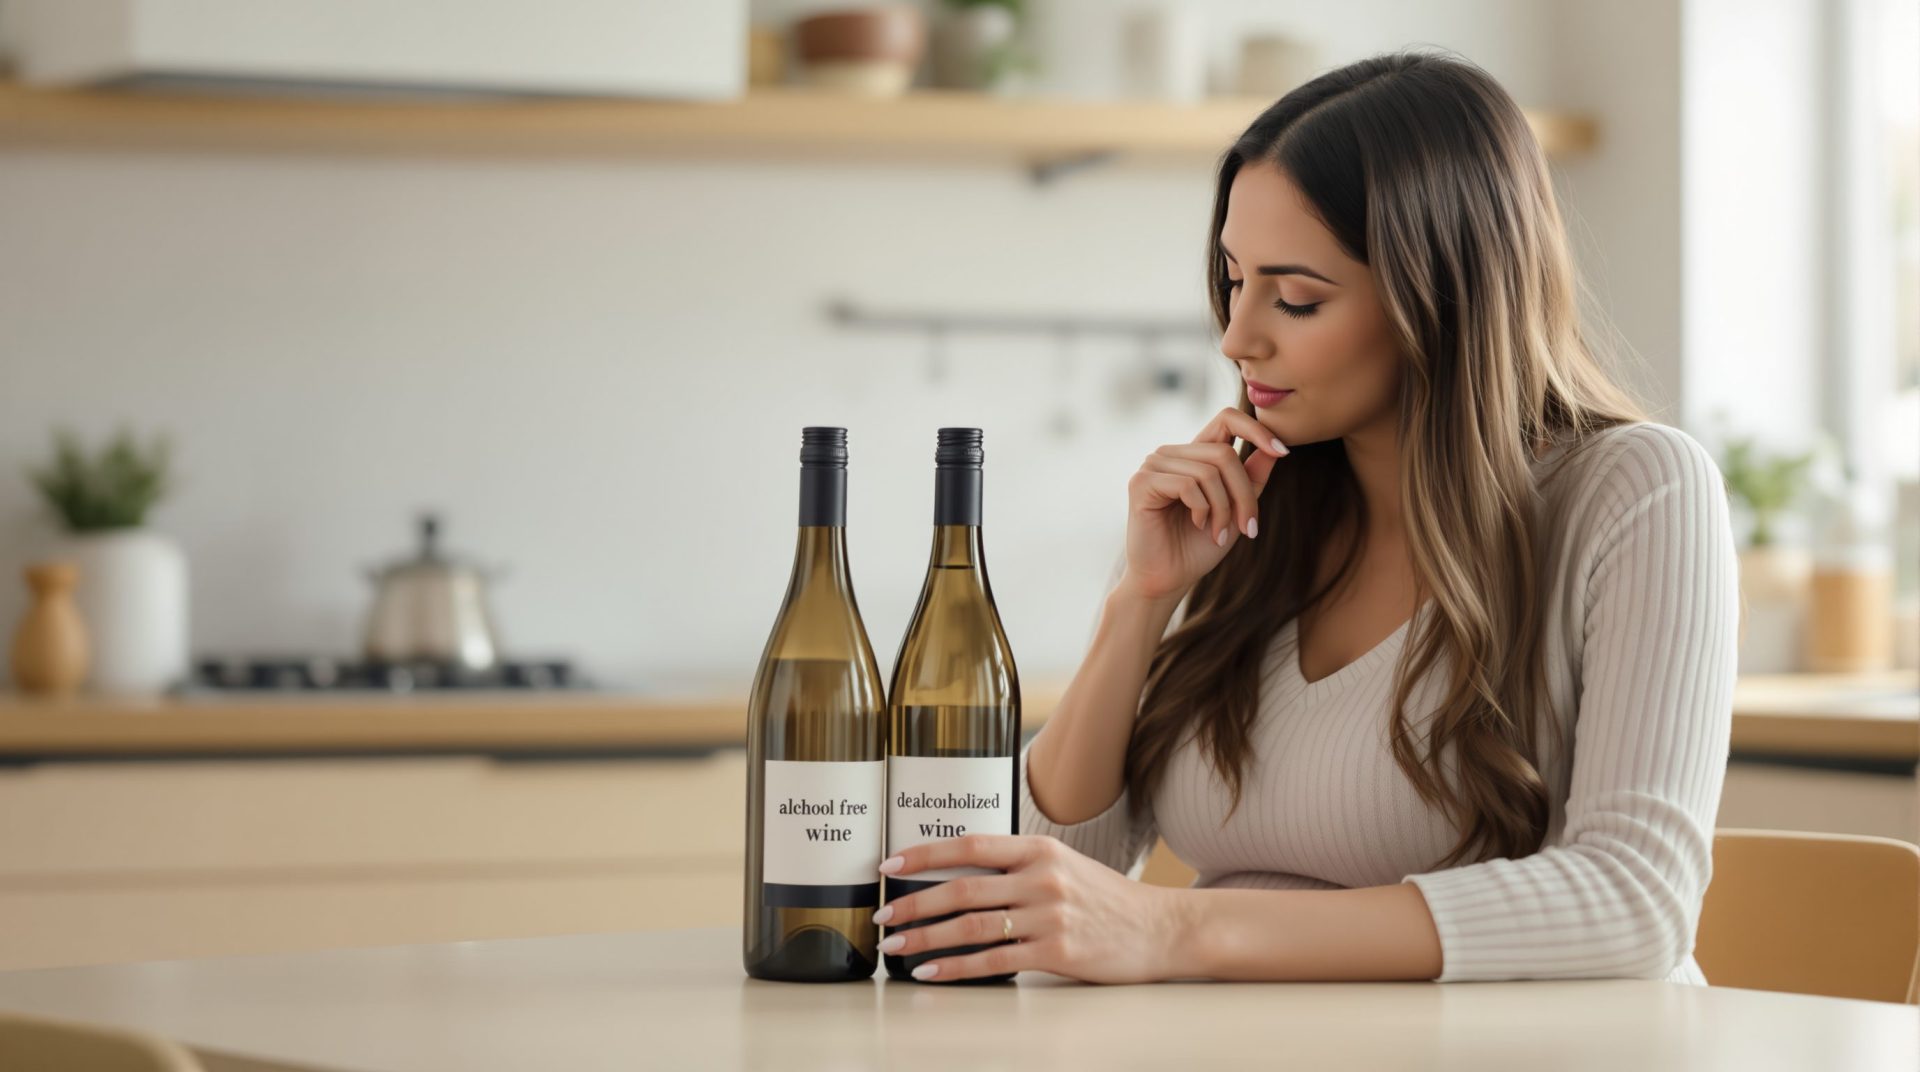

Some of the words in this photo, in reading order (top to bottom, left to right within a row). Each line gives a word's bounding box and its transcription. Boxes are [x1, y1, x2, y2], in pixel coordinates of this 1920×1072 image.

[779, 798, 834, 816] alchool
[839, 799, 868, 816] free
[805, 823, 852, 842] wine
[918, 818, 966, 838] wine
